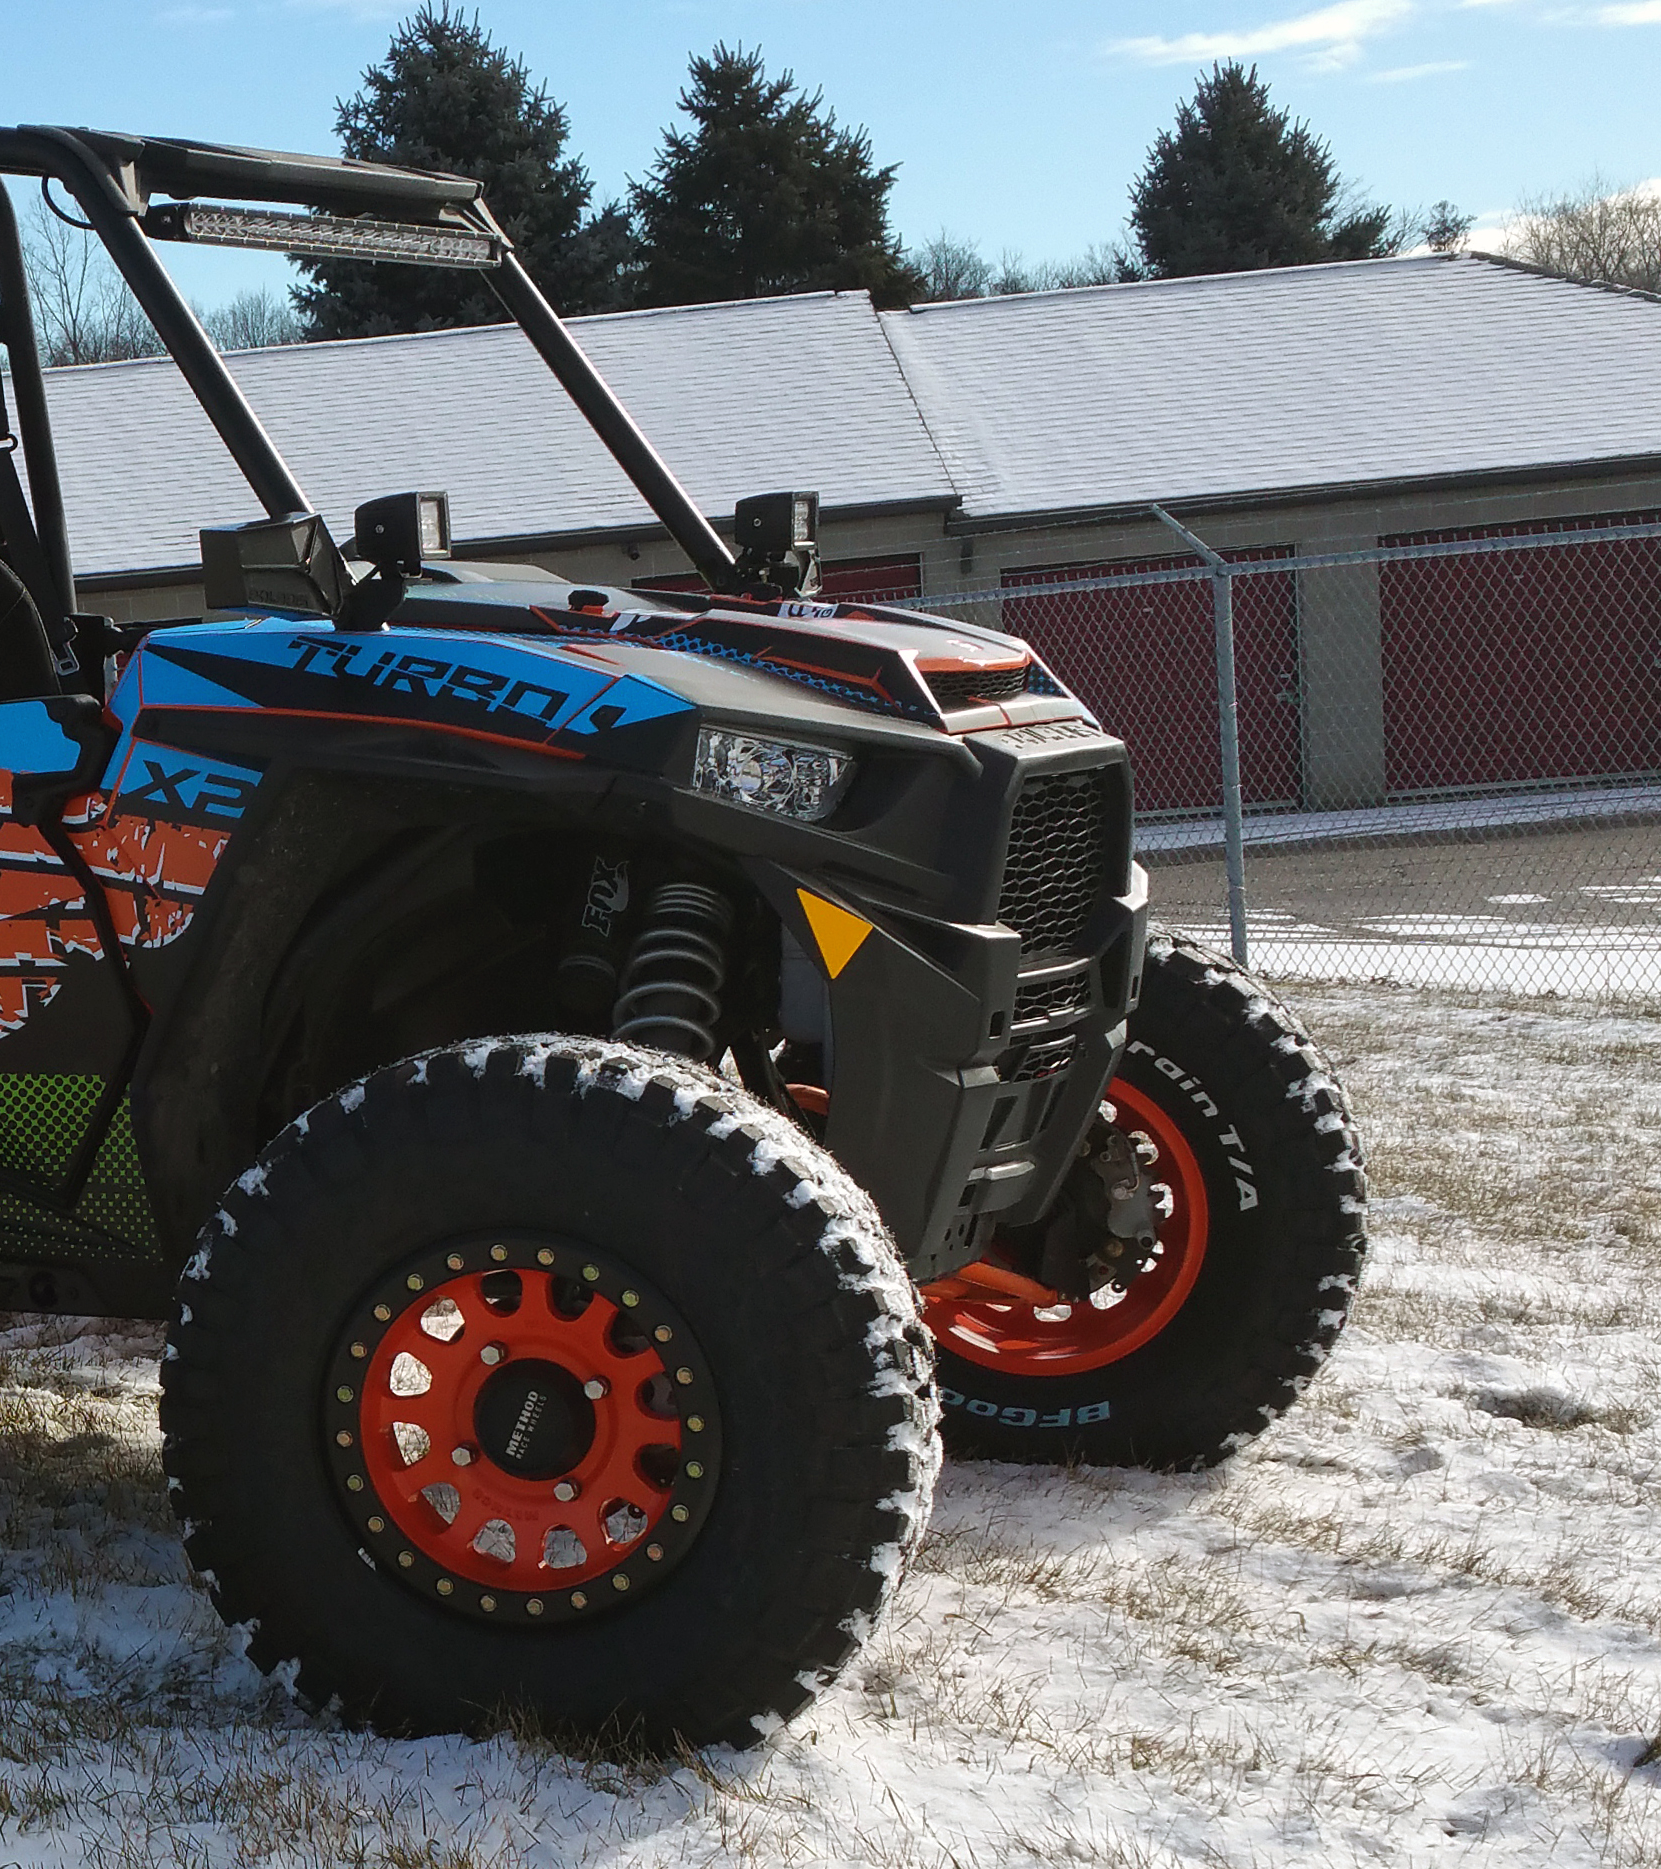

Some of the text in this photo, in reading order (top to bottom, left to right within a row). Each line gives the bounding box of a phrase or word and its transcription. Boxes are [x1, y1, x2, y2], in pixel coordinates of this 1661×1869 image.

[288, 635, 572, 728] TURBO
[581, 855, 629, 937] FOX
[1218, 1123, 1259, 1212] T/A
[505, 1390, 539, 1456] METHOD
[515, 1395, 548, 1460] RACE WHEELS
